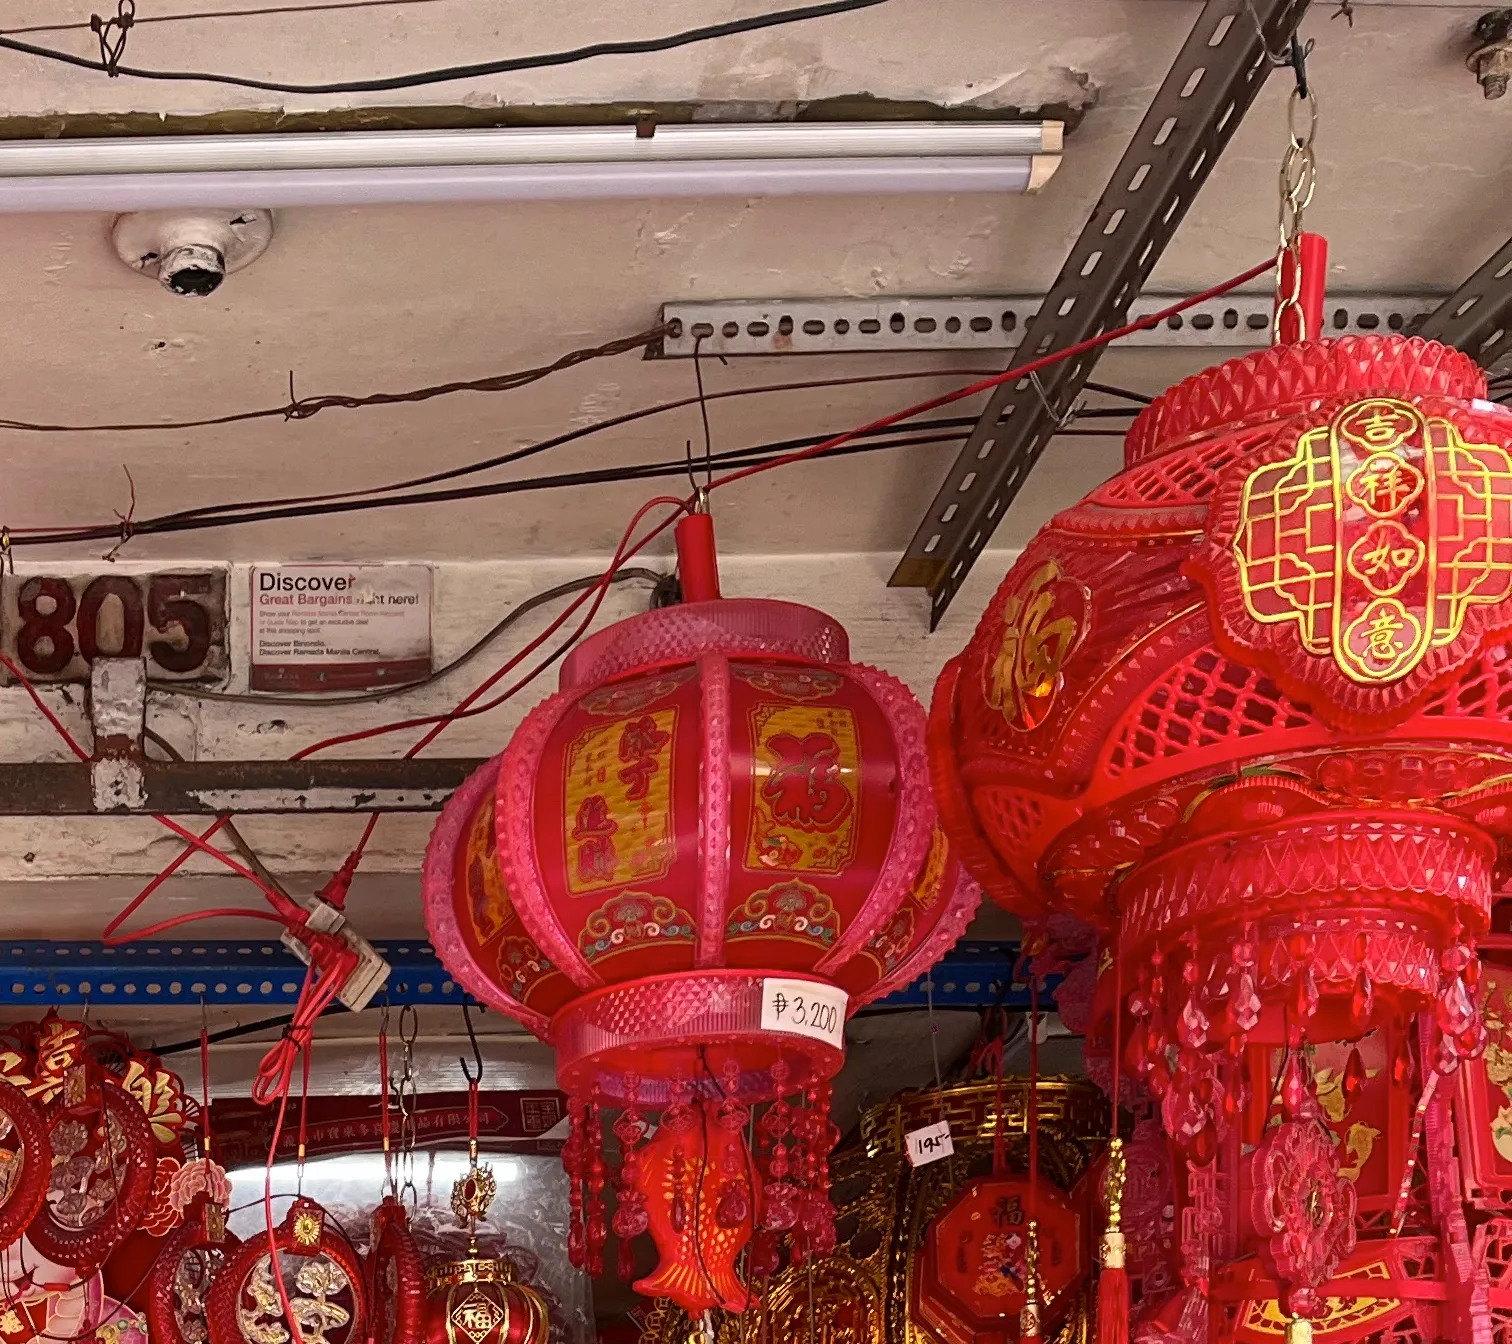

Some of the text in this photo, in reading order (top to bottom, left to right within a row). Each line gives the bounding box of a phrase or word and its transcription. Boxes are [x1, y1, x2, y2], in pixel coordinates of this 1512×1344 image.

[1356, 407, 1416, 660] 吉祥如意
[259, 572, 356, 591] Discover
[259, 593, 294, 605] Great
[297, 593, 353, 607] Bargains
[18, 575, 223, 674] 805
[993, 1195, 1025, 1229] 福
[463, 1300, 490, 1330] 福
